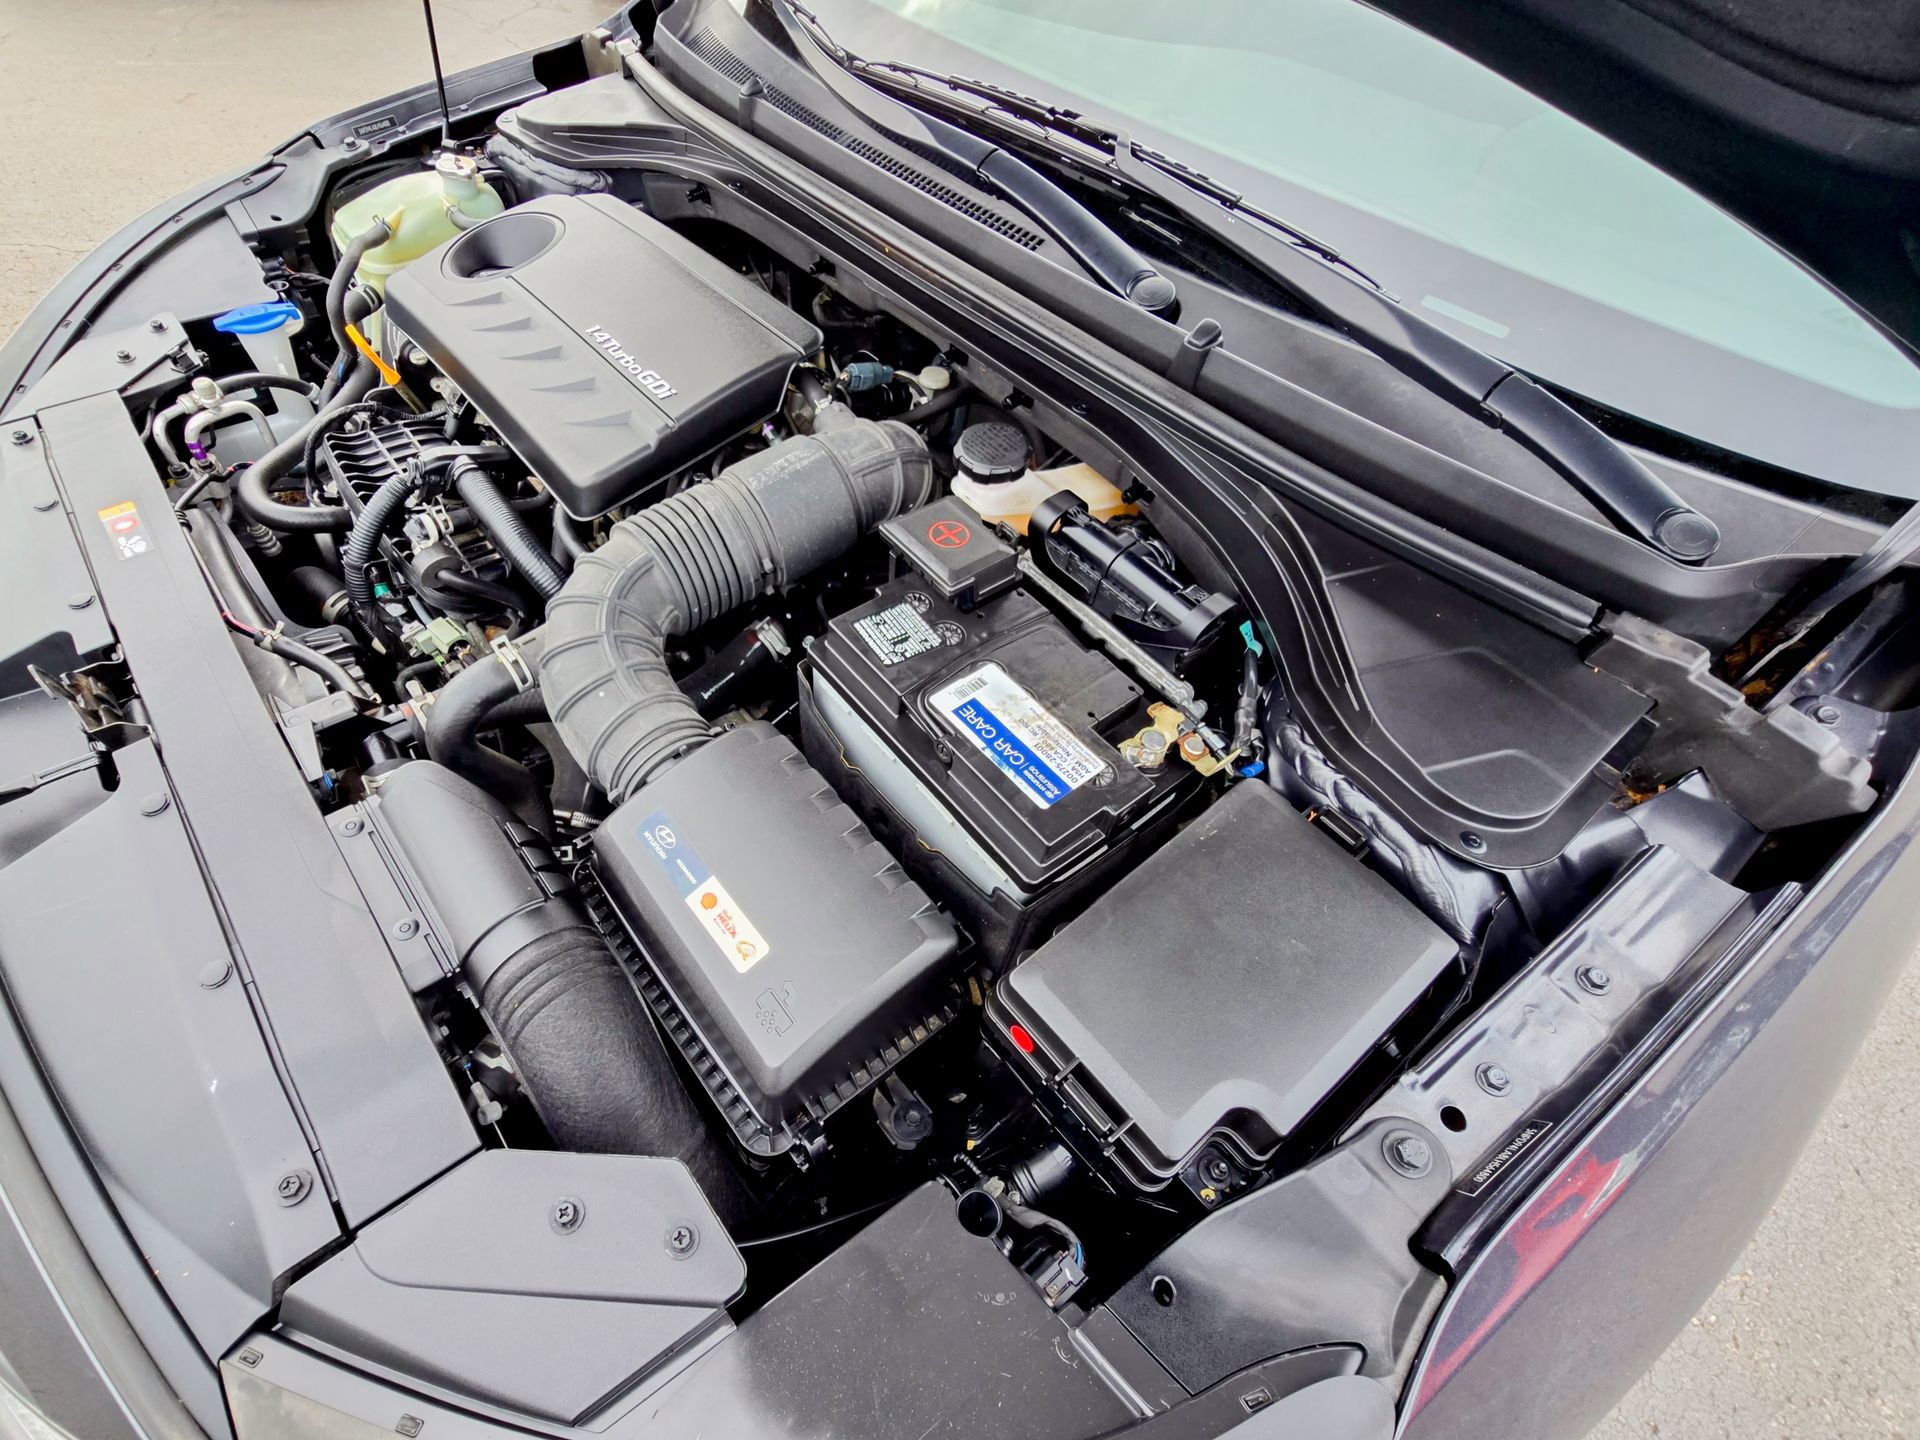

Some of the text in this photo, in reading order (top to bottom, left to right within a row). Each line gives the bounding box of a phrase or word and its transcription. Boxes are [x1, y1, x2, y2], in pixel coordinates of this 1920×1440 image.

[958, 705, 997, 739] CARE
[994, 737, 1025, 765] CAR
[1034, 742, 1079, 784] 00275-28001
[1054, 750, 1068, 763] CCA
[1023, 769, 1047, 792] HYUNDAI
[1028, 765, 1061, 795] Assurance
[1075, 760, 1092, 774] AGM
[643, 830, 668, 860] HYUNDAI
[717, 912, 737, 938] HELIX
